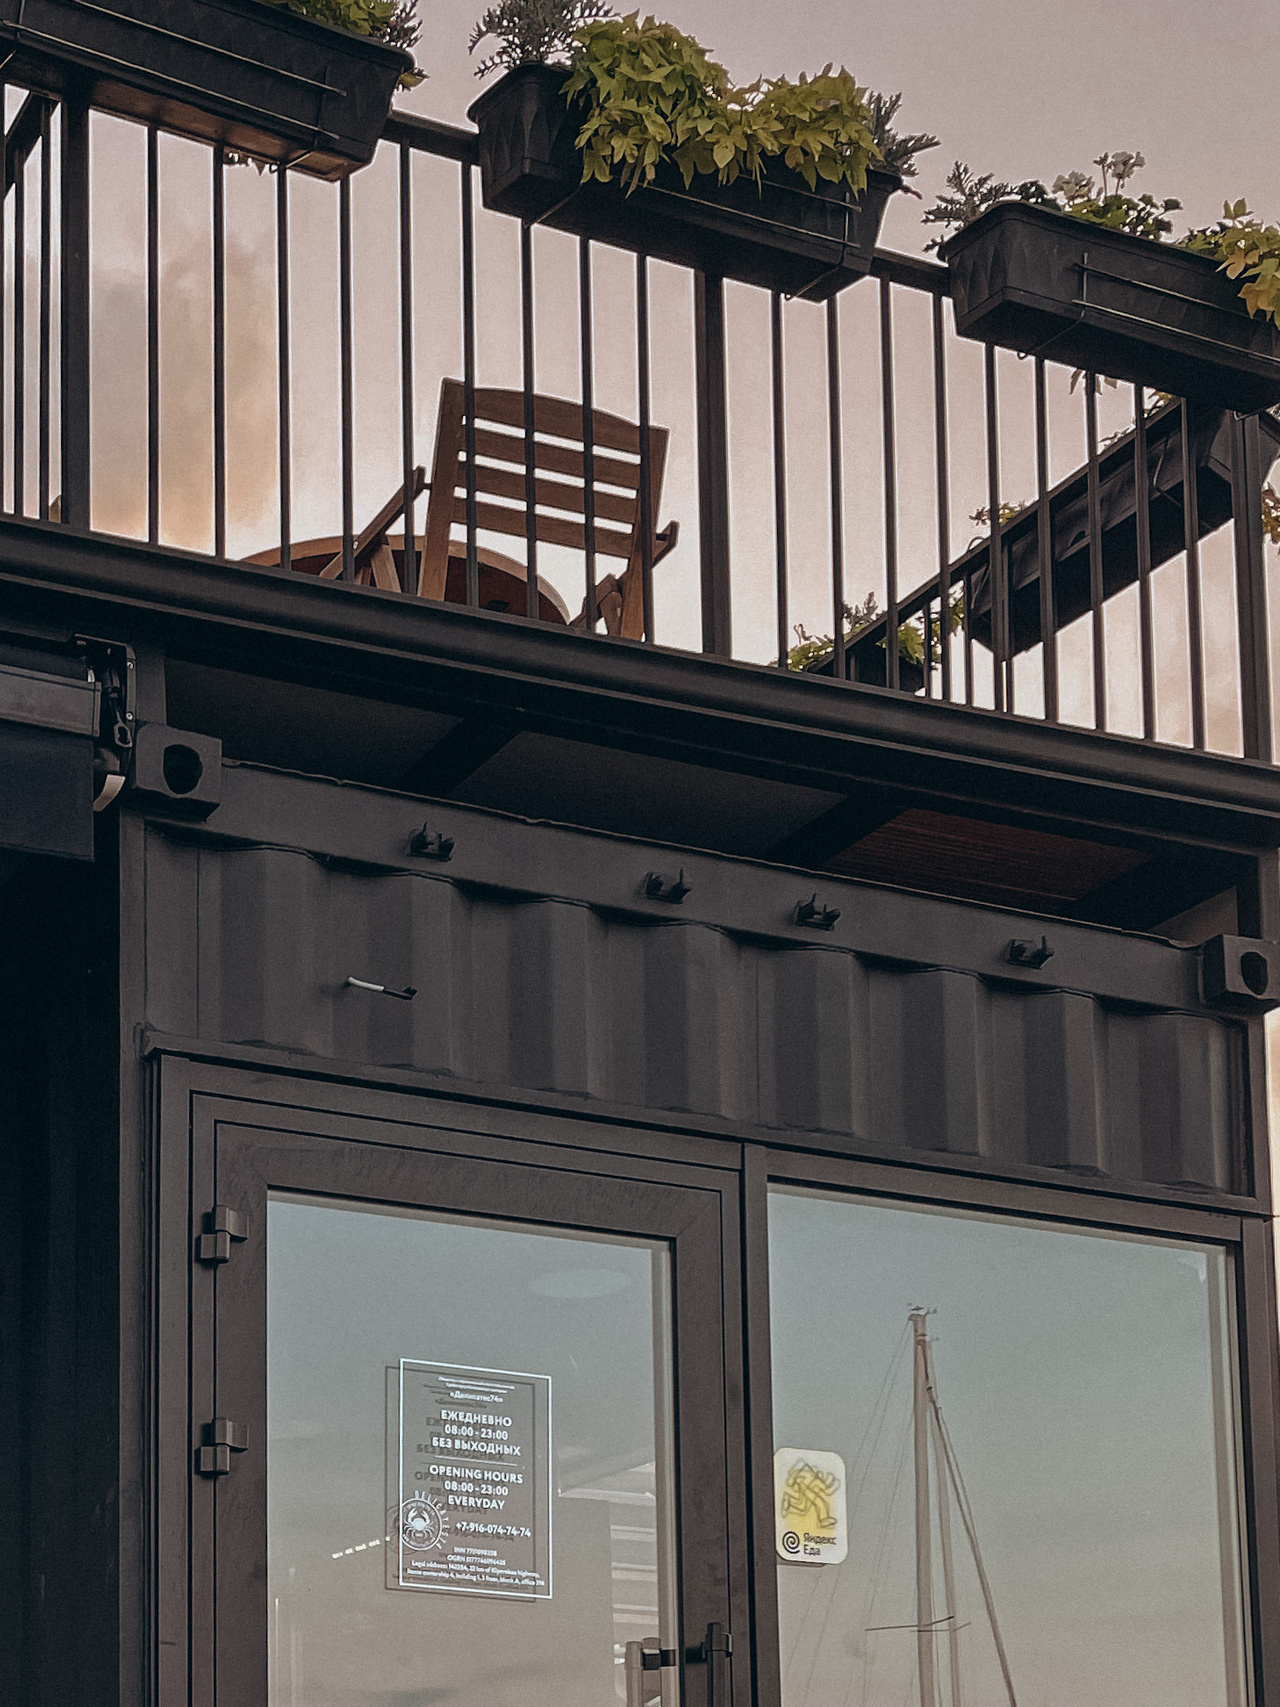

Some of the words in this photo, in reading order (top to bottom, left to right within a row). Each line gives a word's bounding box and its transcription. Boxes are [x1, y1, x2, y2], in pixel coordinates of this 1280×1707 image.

[441, 1409, 512, 1427] ЕЖЕДНЕВНО
[432, 1436, 452, 1448] БЕЗ
[454, 1439, 521, 1456] ВЫХОДНЫХ
[429, 1464, 482, 1479] OPENING
[484, 1470, 523, 1484] HOURS
[448, 1494, 505, 1510] EVERYDAY
[456, 1521, 532, 1538] +7-916-074-74-74
